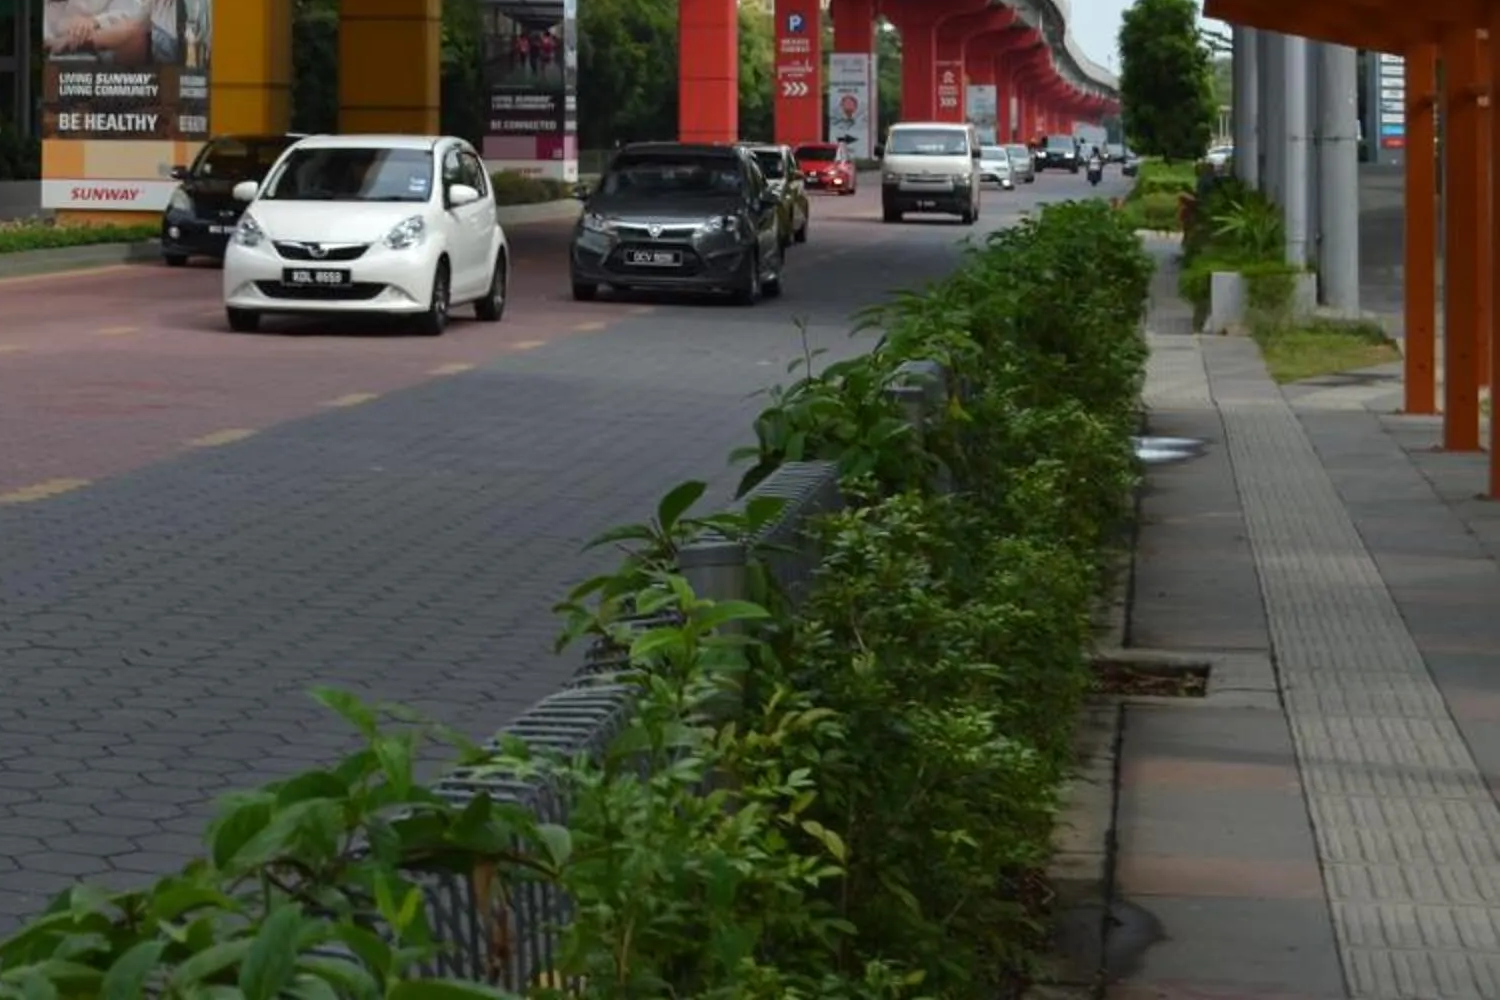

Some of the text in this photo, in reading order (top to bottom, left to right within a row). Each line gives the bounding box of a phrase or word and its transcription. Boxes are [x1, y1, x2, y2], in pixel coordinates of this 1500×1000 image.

[789, 14, 803, 32] P
[59, 72, 151, 85] LIVING SUNWAY
[59, 85, 159, 97] LIVING COMMUNITY
[59, 113, 81, 131] BE
[84, 113, 159, 131] HEALTHY
[71, 187, 140, 201] SUNWAY
